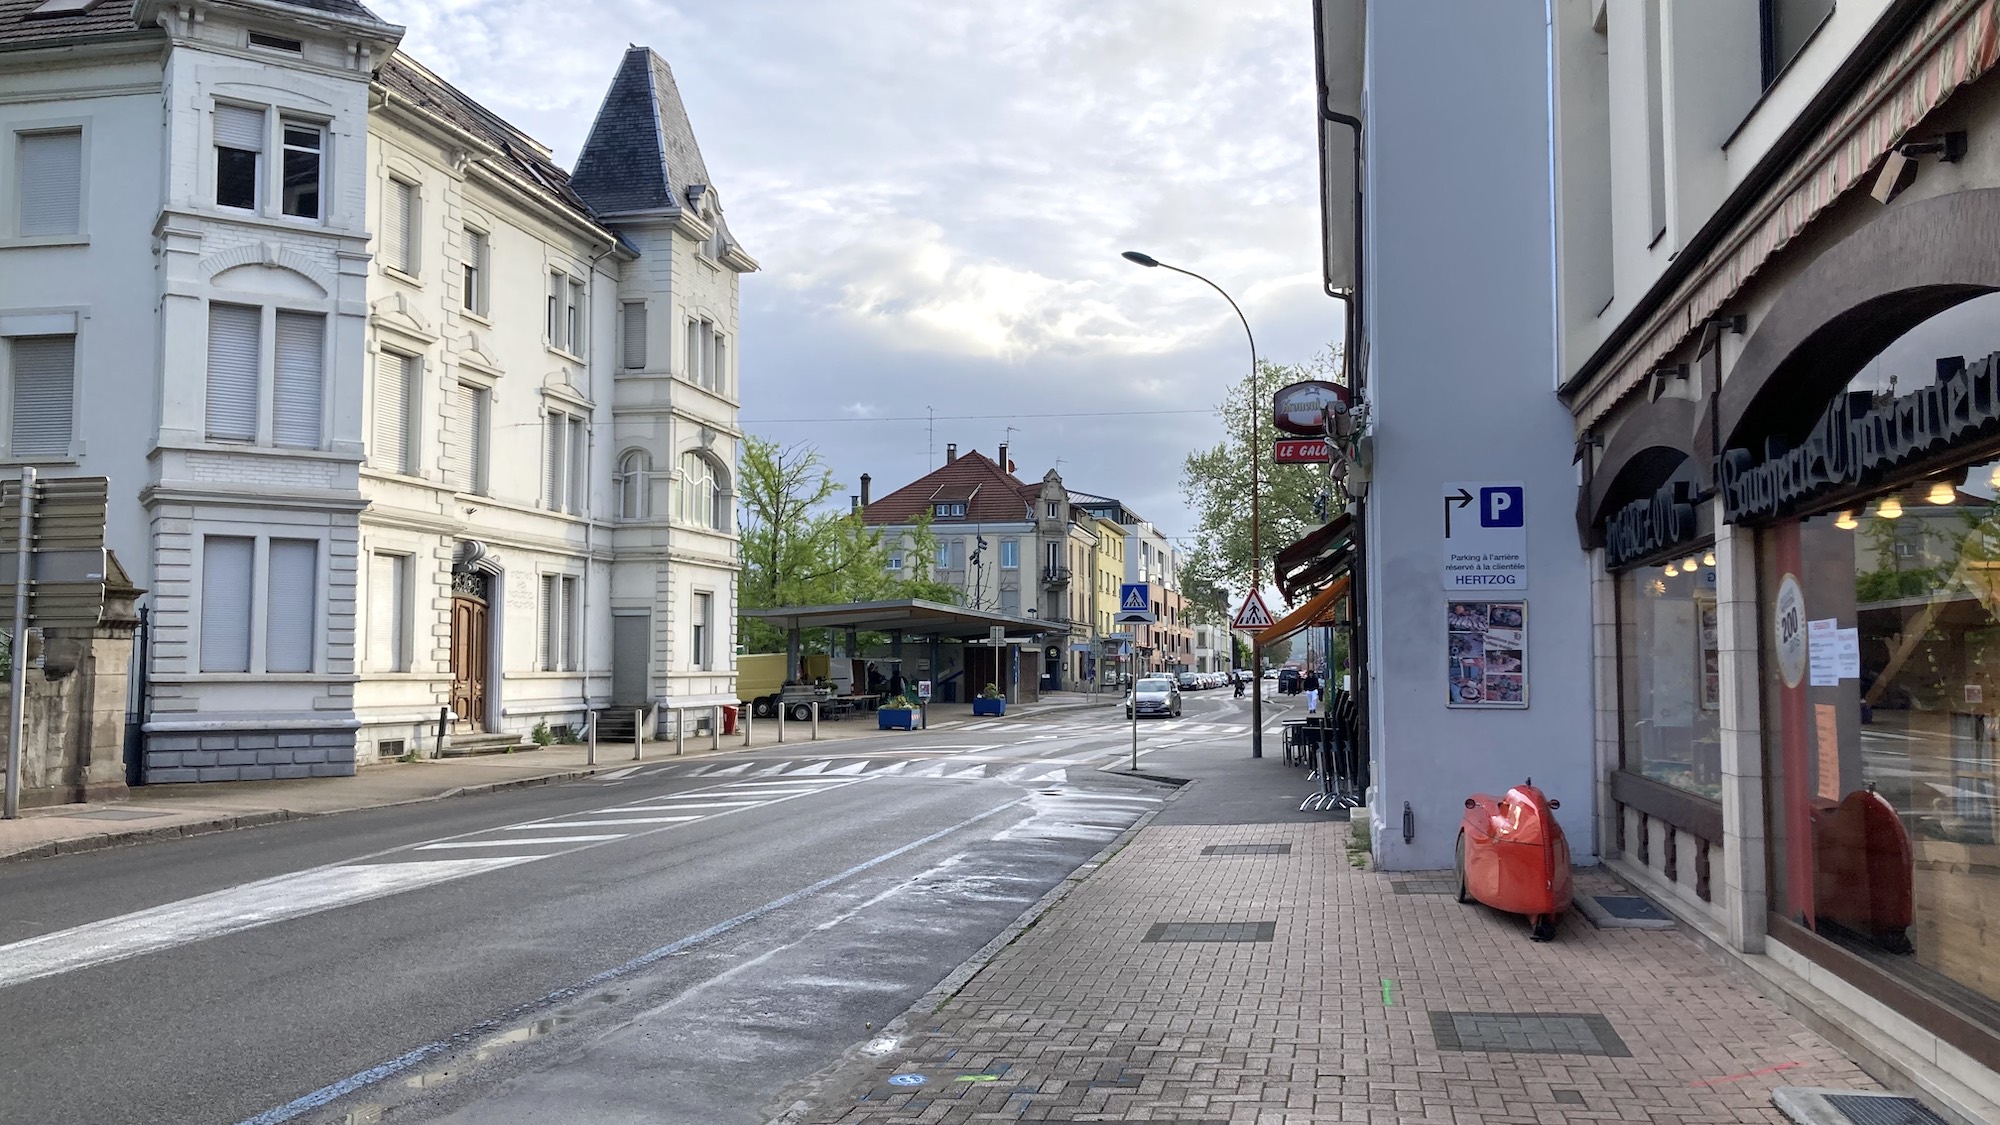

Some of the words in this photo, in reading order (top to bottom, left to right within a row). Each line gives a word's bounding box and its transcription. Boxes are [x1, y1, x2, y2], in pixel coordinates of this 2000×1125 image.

[1280, 445, 1294, 457] LE
[1299, 444, 1329, 457] GALO
[1491, 492, 1511, 520] P
[1451, 554, 1481, 562] Parking
[1482, 553, 1488, 561] à
[1489, 553, 1519, 561] l'arrière
[1445, 563, 1475, 571] réservé
[1476, 563, 1481, 571] à
[1483, 563, 1491, 571] la
[1455, 574, 1516, 585] HERTZOG
[1781, 607, 1799, 644] 200
